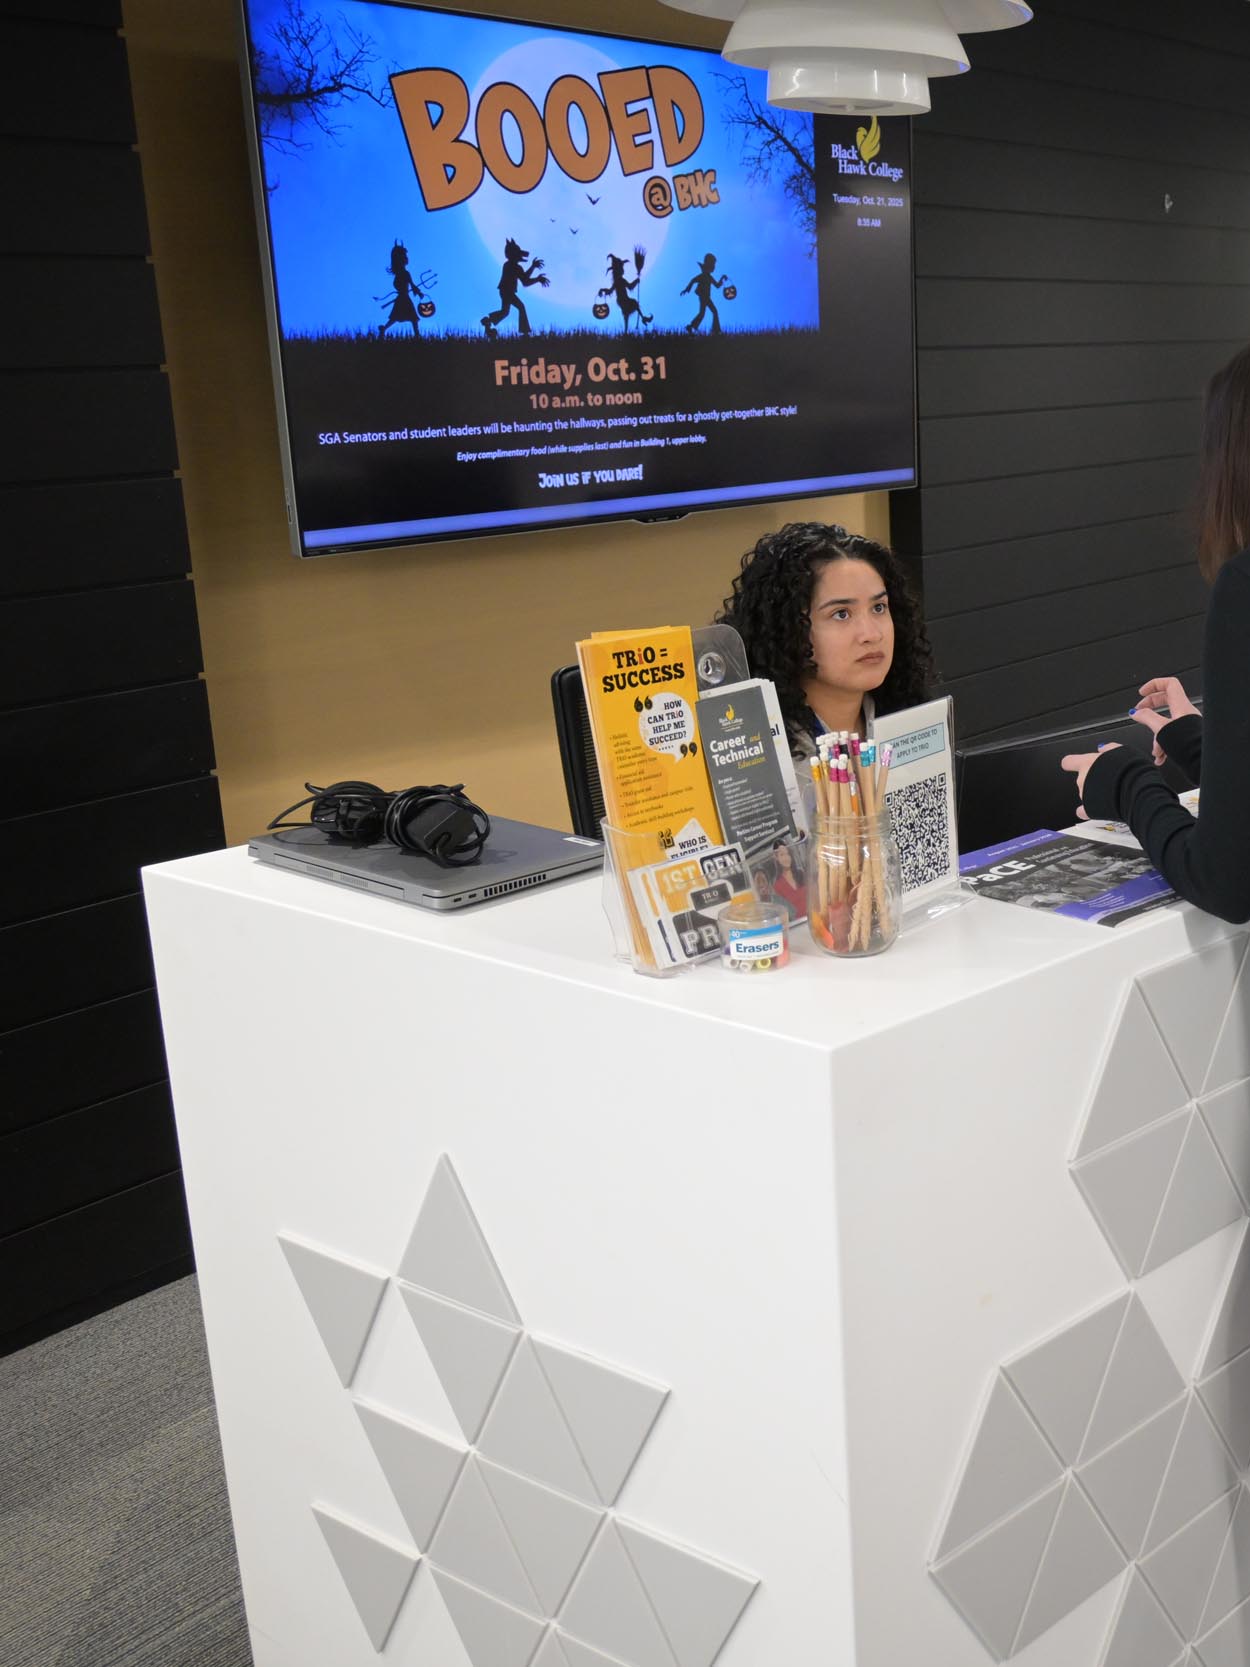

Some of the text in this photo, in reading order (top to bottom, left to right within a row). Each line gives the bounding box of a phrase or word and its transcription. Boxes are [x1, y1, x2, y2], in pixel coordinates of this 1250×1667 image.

[389, 65, 705, 212] BOOED
[831, 144, 858, 160] Black
[838, 159, 903, 182] Hawk College
[643, 169, 720, 218] @ BHC
[832, 193, 861, 205] Tuesday,
[494, 356, 667, 390] Friday, Oct. 31
[529, 392, 643, 409] 10 a.m. to noon
[319, 404, 798, 445] SGA Senators and student leaders will be haunting the hallways, passing out treats for a ghostly get-together BHC style!
[457, 451, 477, 462] Enjoy
[478, 447, 530, 461] complimentary
[531, 446, 547, 456] food
[547, 445, 568, 456] (while
[568, 443, 594, 455] supplies
[609, 441, 621, 450] and
[623, 440, 632, 449] fun
[633, 439, 640, 448] in
[640, 437, 666, 449] Building
[566, 470, 579, 485] US
[593, 467, 614, 482] YOU
[616, 464, 643, 480] DARE!
[612, 646, 656, 669] TRiO
[602, 662, 685, 693] SUCCESS
[664, 700, 682, 710] HOW
[647, 710, 684, 724] CAN TRiO
[653, 720, 686, 734] HELP ME
[648, 730, 687, 746] SUCCEED?
[710, 735, 746, 753] Career
[900, 738, 910, 746] THE
[910, 735, 917, 744] QR
[917, 731, 931, 741] CODE
[712, 741, 764, 767] Technical
[896, 749, 911, 759] APPLY
[679, 835, 707, 849] WHO IS
[735, 941, 780, 953] Erasers
